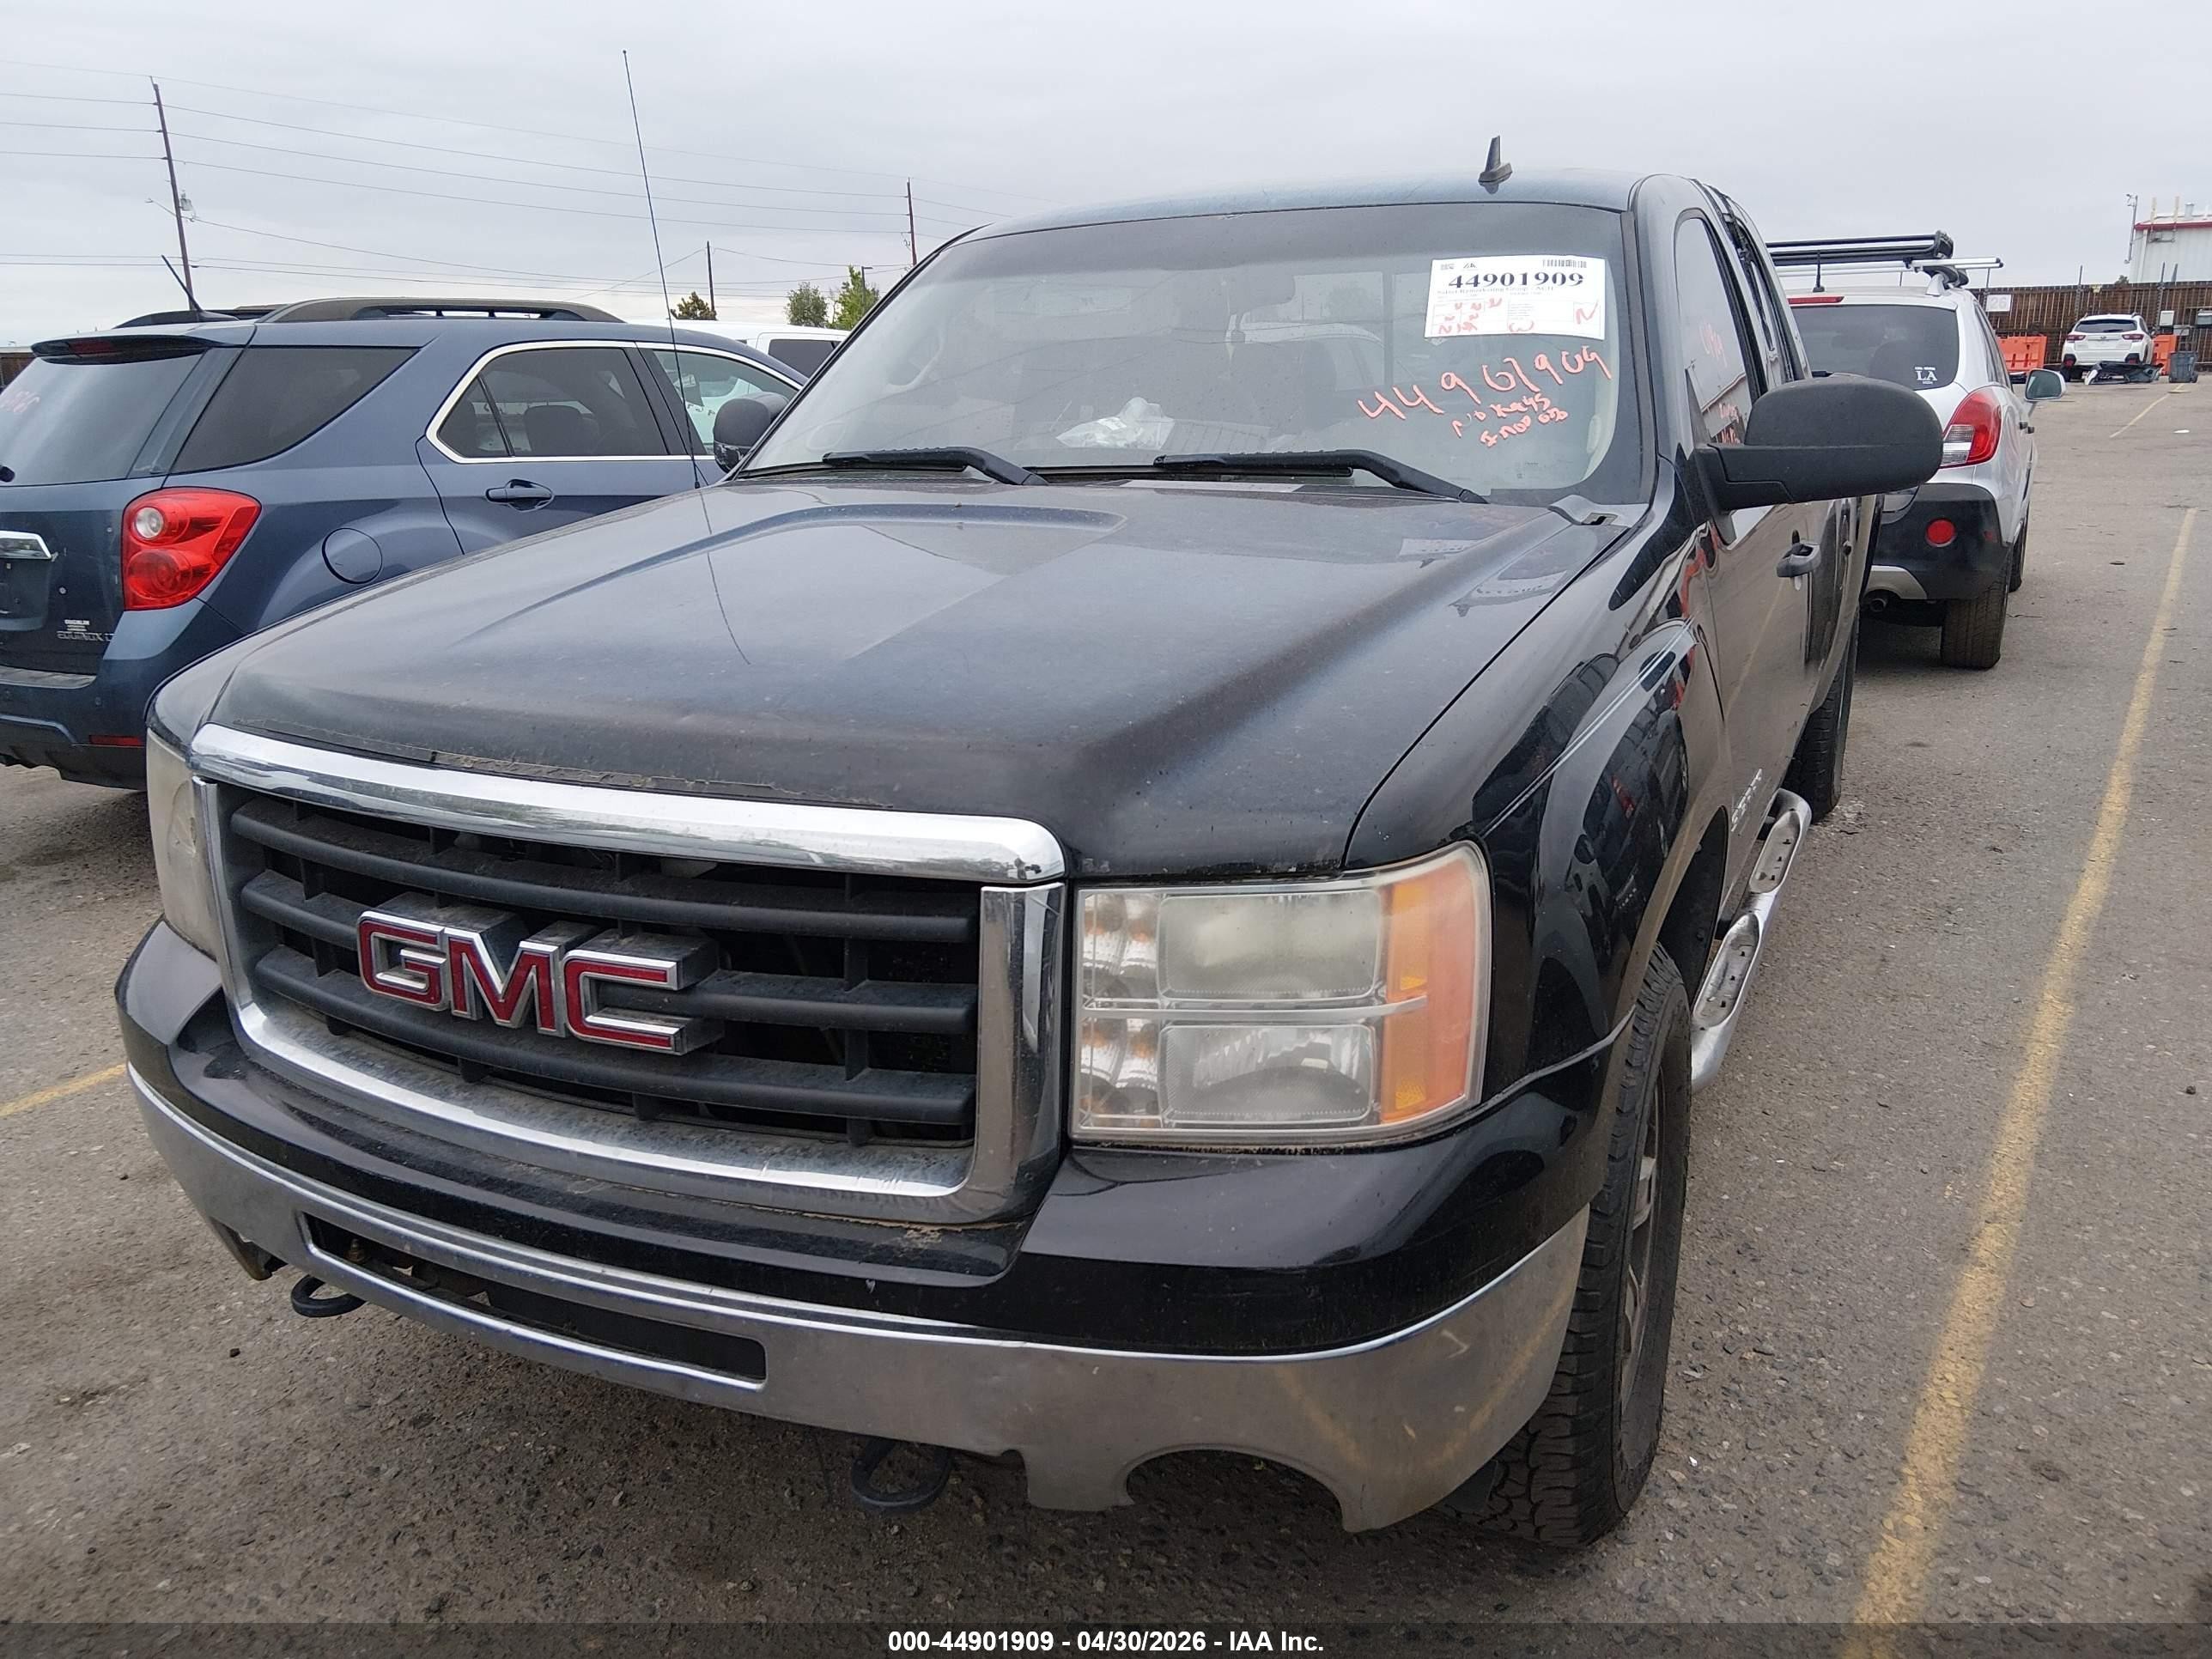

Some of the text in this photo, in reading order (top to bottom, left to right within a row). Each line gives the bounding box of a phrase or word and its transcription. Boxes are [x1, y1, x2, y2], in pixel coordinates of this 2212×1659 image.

[1448, 271, 1584, 289] 44901909
[1990, 296, 2007, 309] 26
[1916, 370, 1938, 381] LA
[356, 910, 689, 1056] GMC
